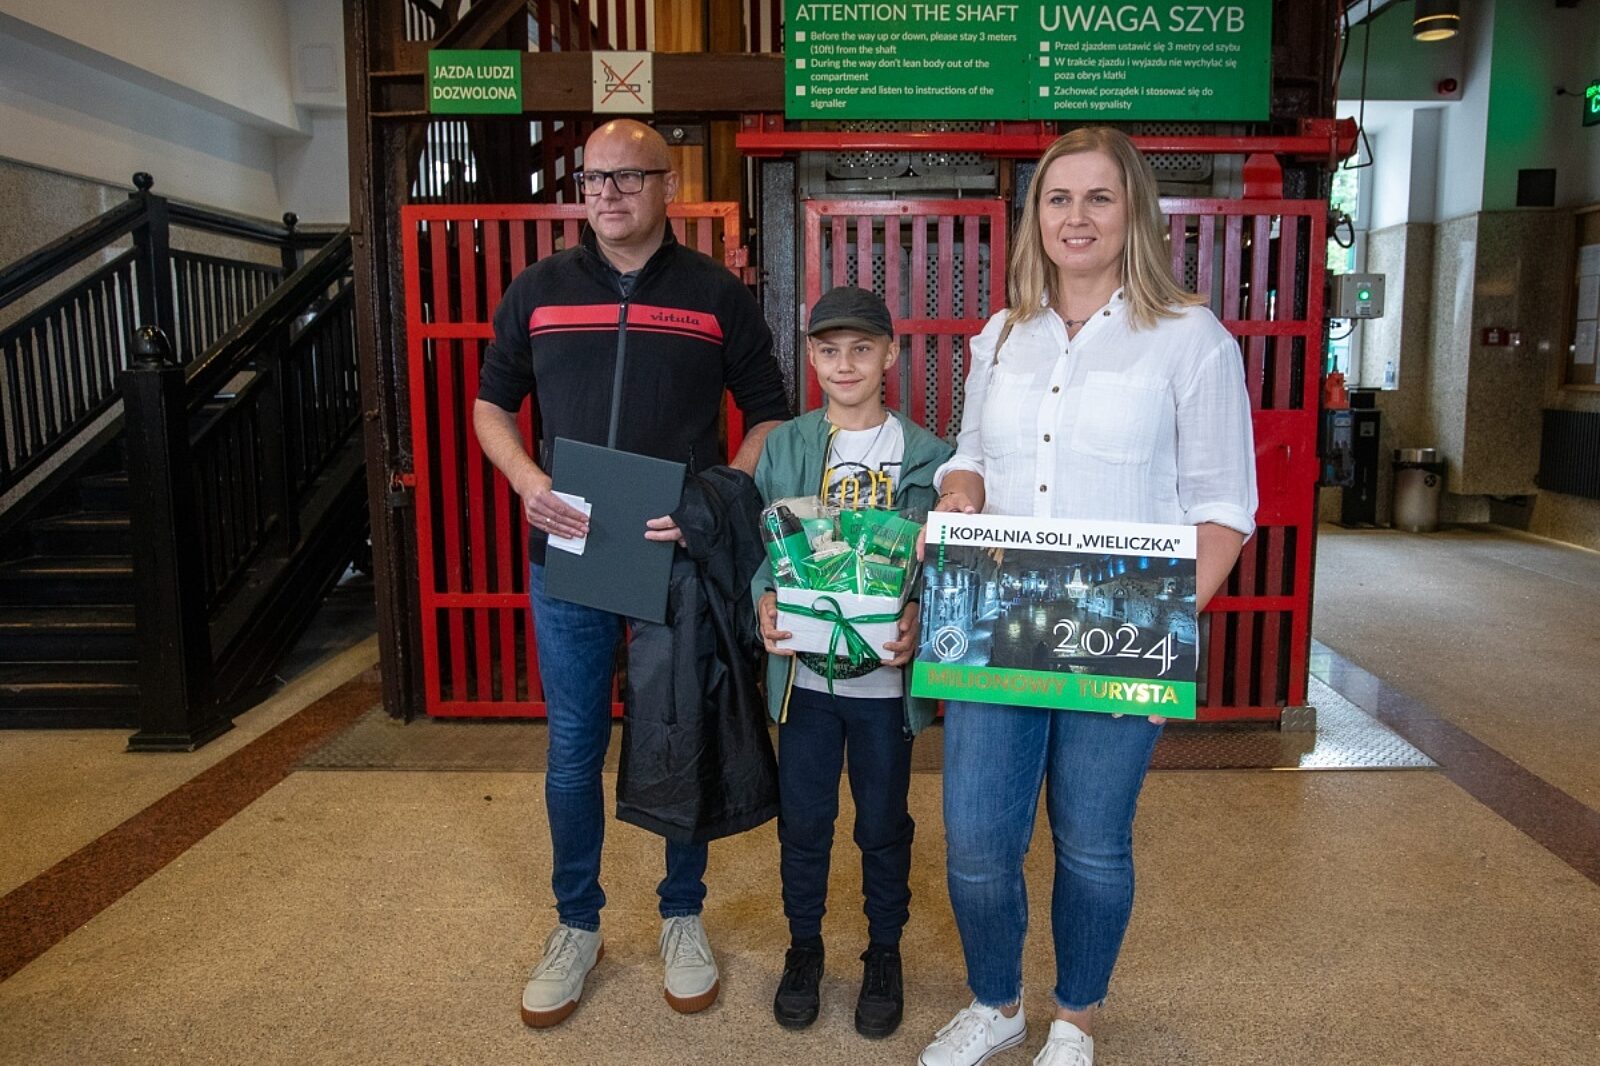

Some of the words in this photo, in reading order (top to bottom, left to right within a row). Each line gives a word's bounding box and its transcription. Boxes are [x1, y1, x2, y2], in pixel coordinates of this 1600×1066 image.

[795, 4, 907, 22] ATTENTION
[912, 4, 951, 22] THE
[955, 4, 1019, 22] SHAFT
[1039, 5, 1161, 32] UWAGA
[1168, 6, 1245, 33] SZYB
[810, 31, 840, 41] Before
[841, 31, 856, 41] the
[857, 33, 876, 43] way
[877, 33, 889, 43] up
[890, 33, 901, 41] or
[902, 32, 929, 43] down,
[930, 32, 959, 43] please
[959, 33, 978, 43] stay
[979, 32, 985, 41] 3
[986, 33, 1017, 42] meters
[810, 45, 834, 56] (10ft)
[836, 45, 857, 55] from
[858, 45, 874, 55] the
[875, 45, 897, 55] shaft
[1055, 41, 1080, 51] Przed
[1081, 41, 1117, 52] zjazdem
[1118, 42, 1151, 51] ustawić
[1152, 42, 1166, 52] się
[1167, 42, 1174, 51] 3
[1175, 43, 1201, 53] metry
[1202, 43, 1214, 52] od
[1215, 44, 1241, 53] szybu
[810, 58, 841, 70] During
[842, 58, 857, 68] the
[858, 60, 877, 70] way
[878, 58, 902, 68] don't
[903, 58, 922, 68] lean
[923, 58, 946, 70] body
[946, 59, 963, 68] out
[963, 58, 974, 68] of
[975, 58, 990, 68] the
[1054, 56, 1066, 66] W
[1067, 56, 1097, 67] trakcie
[1098, 57, 1126, 68] zjazdu
[1127, 57, 1131, 66] i
[1131, 57, 1168, 68] wyjazdu
[1168, 57, 1183, 67] nie
[1184, 57, 1223, 69] wychylać
[1224, 58, 1238, 69] się
[433, 65, 475, 80] JAZDA
[476, 65, 515, 80] LUDZI
[810, 72, 869, 83] compartment
[1054, 72, 1076, 82] poza
[1077, 71, 1102, 82] obrys
[1103, 70, 1127, 80] klatki
[433, 86, 517, 100] DOZWOLONA
[810, 85, 834, 96] Keep
[835, 85, 859, 95] order
[860, 85, 877, 95] and
[878, 85, 903, 95] listen
[904, 86, 915, 95] to
[916, 85, 967, 96] instructions
[967, 85, 979, 95] of
[980, 86, 995, 95] the
[1054, 86, 1098, 96] Zachować
[1099, 86, 1140, 98] porządek
[1141, 86, 1145, 96] i
[1145, 87, 1186, 96] stosować
[1187, 87, 1201, 98] się
[1202, 87, 1214, 96] do
[810, 98, 848, 110] signaller
[1054, 99, 1089, 111] poleceń
[1090, 99, 1133, 111] sygnalisty
[650, 312, 700, 325] vistula
[949, 526, 1032, 544] KOPALNIA
[1035, 532, 1072, 546] SOLI
[1076, 534, 1181, 552] „WIELICZKA”
[1052, 618, 1179, 676] 2024
[927, 668, 1068, 696] MILIONOWY
[1078, 679, 1179, 705] TURYSTA
